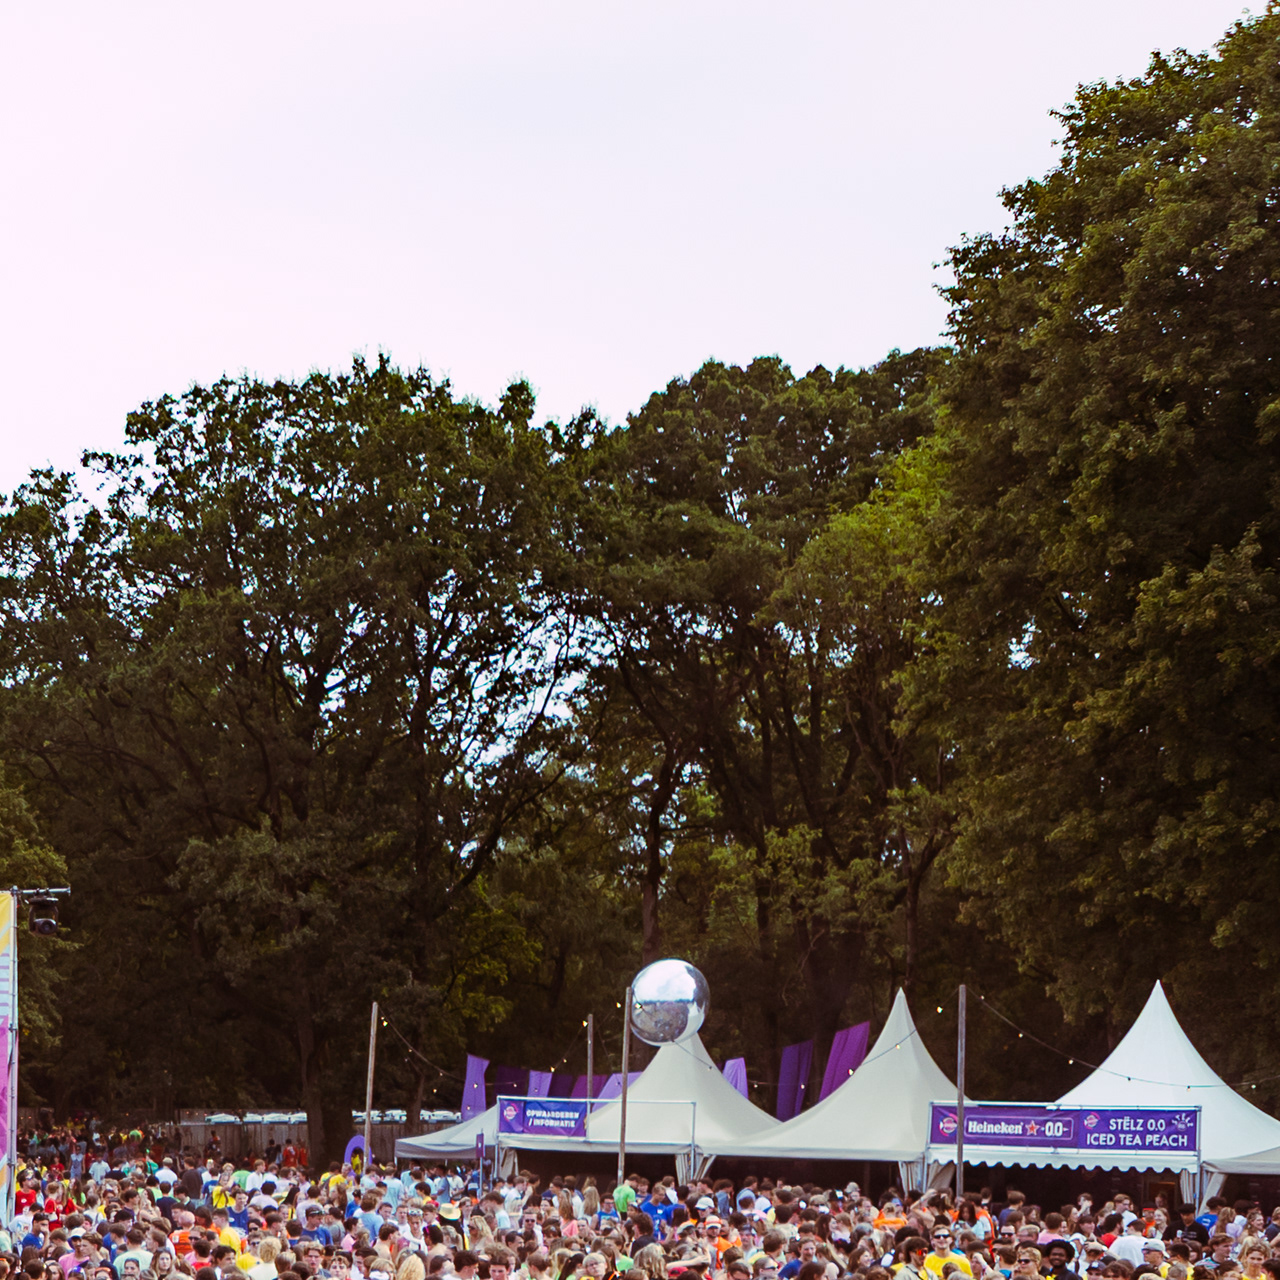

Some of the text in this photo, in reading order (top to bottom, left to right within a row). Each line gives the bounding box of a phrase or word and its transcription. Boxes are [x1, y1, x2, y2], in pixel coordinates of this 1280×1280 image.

[968, 1120, 1024, 1135] Heineken
[1109, 1116, 1144, 1131] STËLZ
[1147, 1119, 1166, 1131] 0.0
[1086, 1133, 1188, 1147] ICED TEA PEACH
